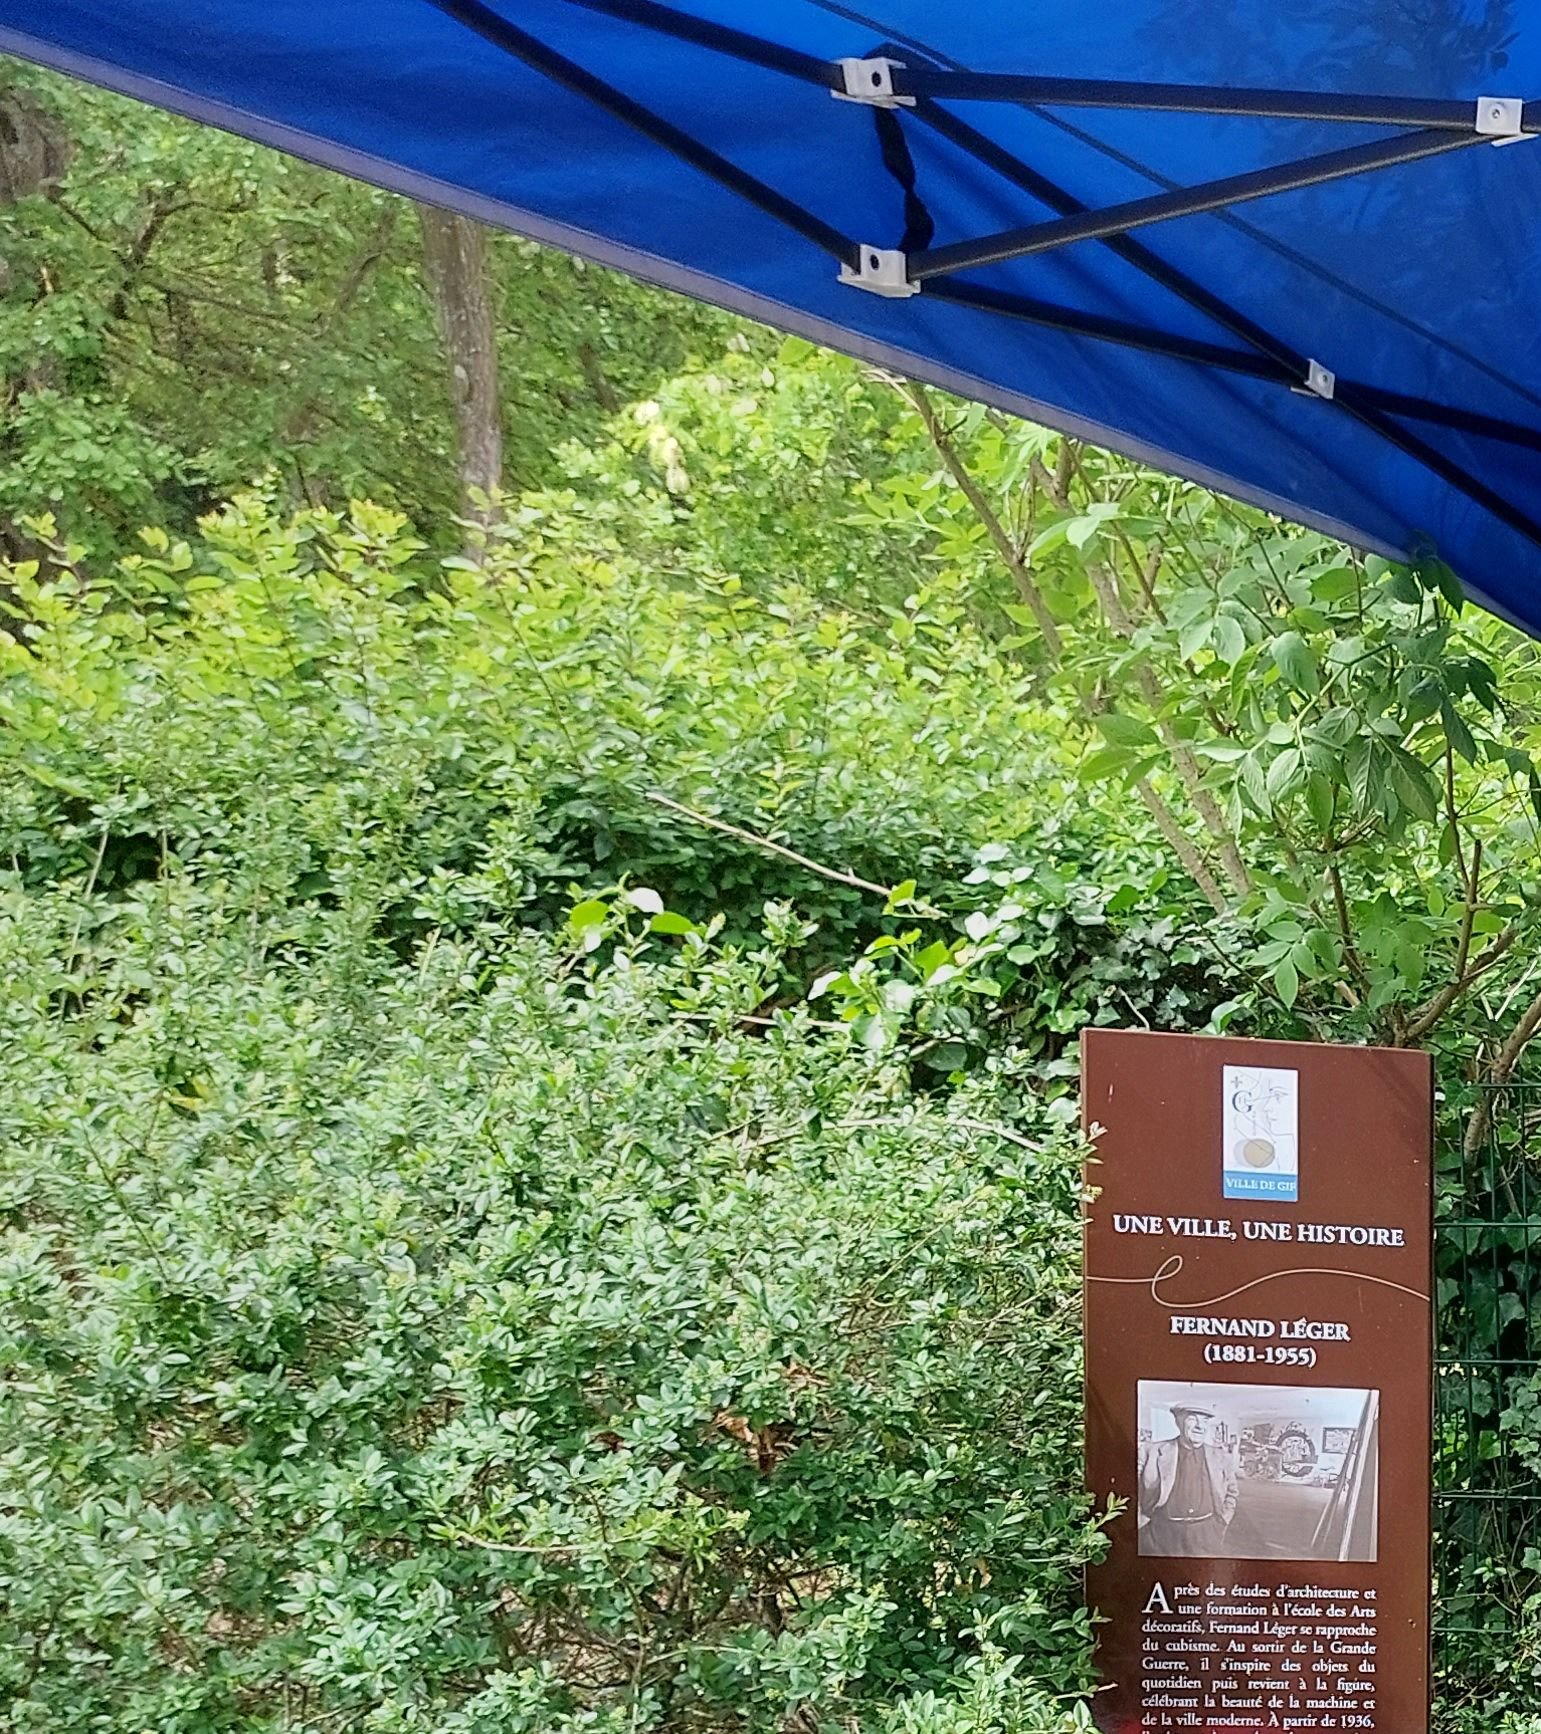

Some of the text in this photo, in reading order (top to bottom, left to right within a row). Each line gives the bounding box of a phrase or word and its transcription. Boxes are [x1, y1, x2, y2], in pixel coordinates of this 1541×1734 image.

[1226, 1178, 1258, 1189] VILLE
[1260, 1181, 1275, 1190] DE
[1113, 1214, 1404, 1247] UNE VILLE, UNE HISTOIRE
[1170, 1316, 1351, 1341] FERNAND LÉGER
[1204, 1344, 1317, 1368] (1881-1955)
[1205, 1586, 1225, 1597] des
[1231, 1586, 1270, 1597] études
[1276, 1585, 1359, 1599] d'architecture
[1364, 1589, 1376, 1599] et
[1178, 1603, 1376, 1617] une formation à l'école des Arts
[1142, 1622, 1376, 1639] décoratifs, Fernand Léger se rapproche
[1143, 1639, 1376, 1653] du cubisme. Au sortir de la Grande
[1142, 1658, 1375, 1675] Guerre, il s'inspire des objets du
[1142, 1676, 1201, 1691] quotidien
[1212, 1677, 1238, 1691] puis
[1248, 1678, 1289, 1690] revient
[1299, 1677, 1306, 1689] à
[1317, 1677, 1327, 1690] la
[1142, 1694, 1375, 1709] célébrant la beauté de la machine et
[1142, 1712, 1375, 1730] de la ville moderne. À partir de 1936,
